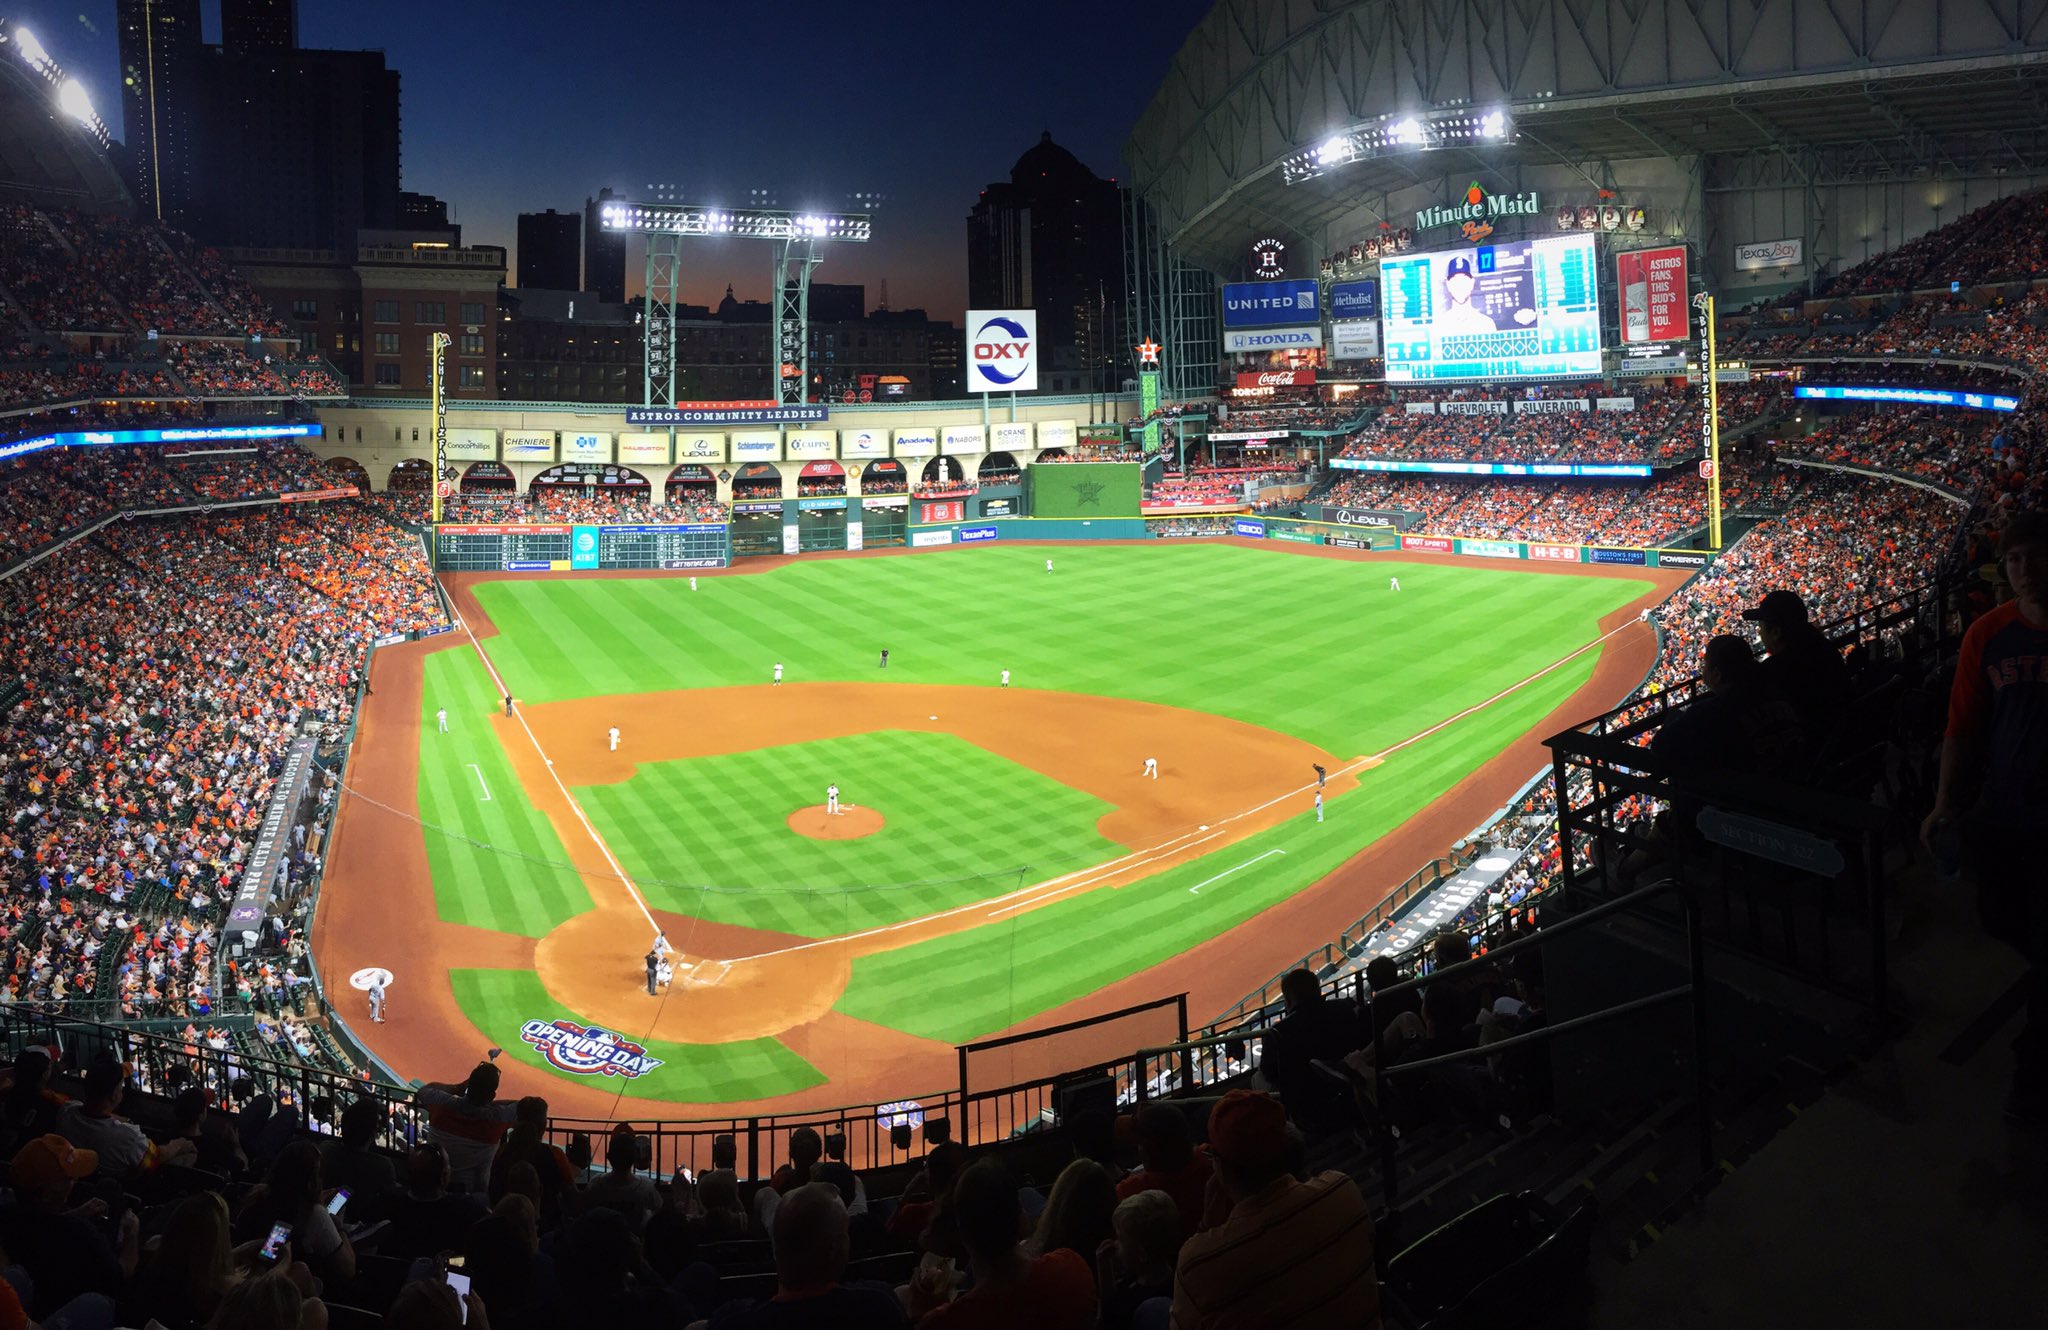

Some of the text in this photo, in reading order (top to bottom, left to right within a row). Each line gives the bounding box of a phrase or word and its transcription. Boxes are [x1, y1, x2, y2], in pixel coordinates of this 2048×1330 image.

[1416, 192, 1539, 231] Minute Maid
[1253, 239, 1284, 252] HOUSTON
[1736, 242, 1798, 260] Texas Bay
[1262, 252, 1276, 266] H
[1481, 253, 1492, 268] 17
[1650, 258, 1681, 270] ASTROS
[1256, 267, 1284, 278] ASTROS
[1650, 270, 1673, 282] FANS,
[1651, 282, 1669, 292] THIS
[1228, 296, 1293, 310] UNITED
[1333, 293, 1372, 306] Methodist
[1652, 292, 1676, 304] BUD'S
[1652, 304, 1668, 315] FOR
[1652, 316, 1671, 326] YOU.
[1248, 333, 1314, 345] HONDA
[974, 343, 1030, 360] OXY
[1140, 344, 1158, 362] H
[1232, 387, 1275, 396] TORCHYS
[1699, 316, 1712, 458] BURGERZ R FOUL
[1447, 403, 1502, 414] CHEVROLET
[1523, 401, 1581, 413] SILVERADO
[438, 357, 446, 480] CHIKIN IZ FARE
[766, 410, 822, 418] LEADERS
[448, 442, 491, 450] ConocoPhillips
[737, 442, 775, 450] Schlumberger
[1351, 516, 1389, 525] LEXUS
[961, 530, 995, 540] TexanPlus
[1238, 524, 1262, 534] GEICO
[1406, 537, 1448, 547] ROOT SPORTS
[1660, 556, 1705, 565] POWERADE
[280, 752, 302, 788] WELCOME
[279, 790, 290, 801] TO
[263, 802, 286, 838] MINUTE
[1721, 824, 1785, 851] SECTION
[252, 840, 272, 868] MAID
[239, 870, 263, 900] PARK
[523, 1020, 660, 1073] OPENING DAY
